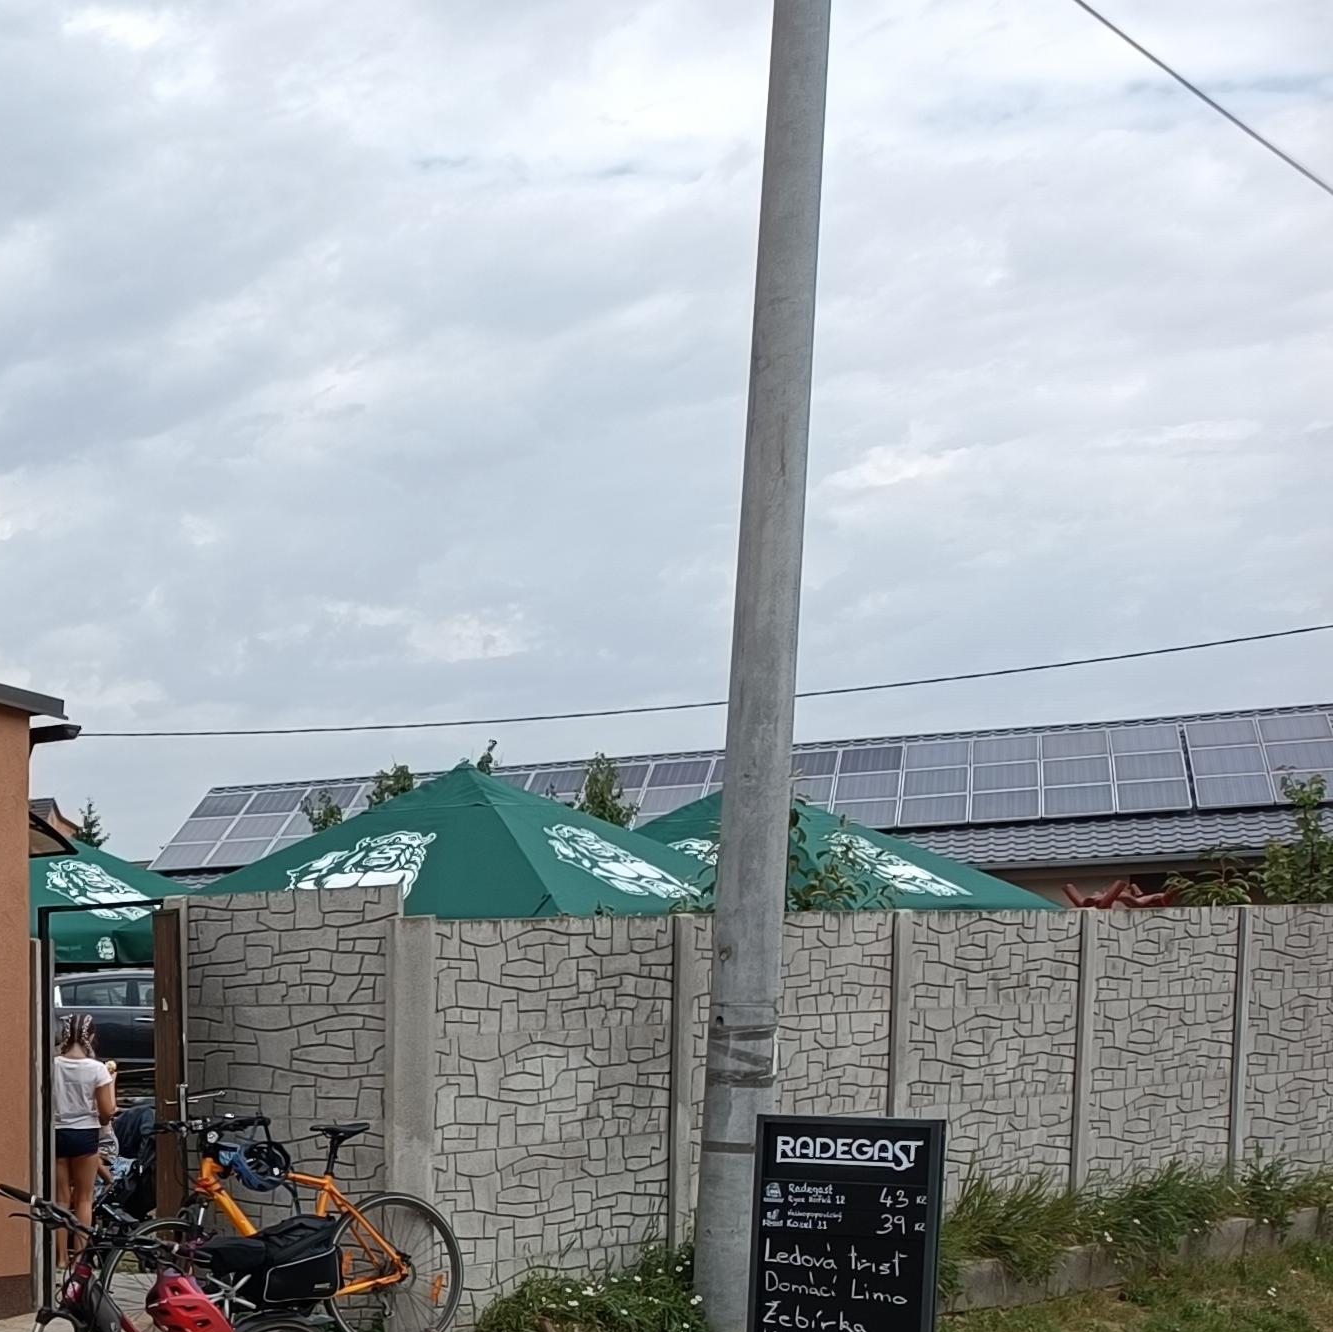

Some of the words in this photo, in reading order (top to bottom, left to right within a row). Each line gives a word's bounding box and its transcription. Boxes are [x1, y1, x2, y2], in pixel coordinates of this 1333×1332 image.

[776, 1135, 925, 1171] RADEGAST
[879, 1187, 909, 1207] 43
[876, 1213, 906, 1235] 39
[764, 1237, 838, 1270] Ledová
[765, 1270, 838, 1297] Domácí
[851, 1278, 908, 1304] Limo
